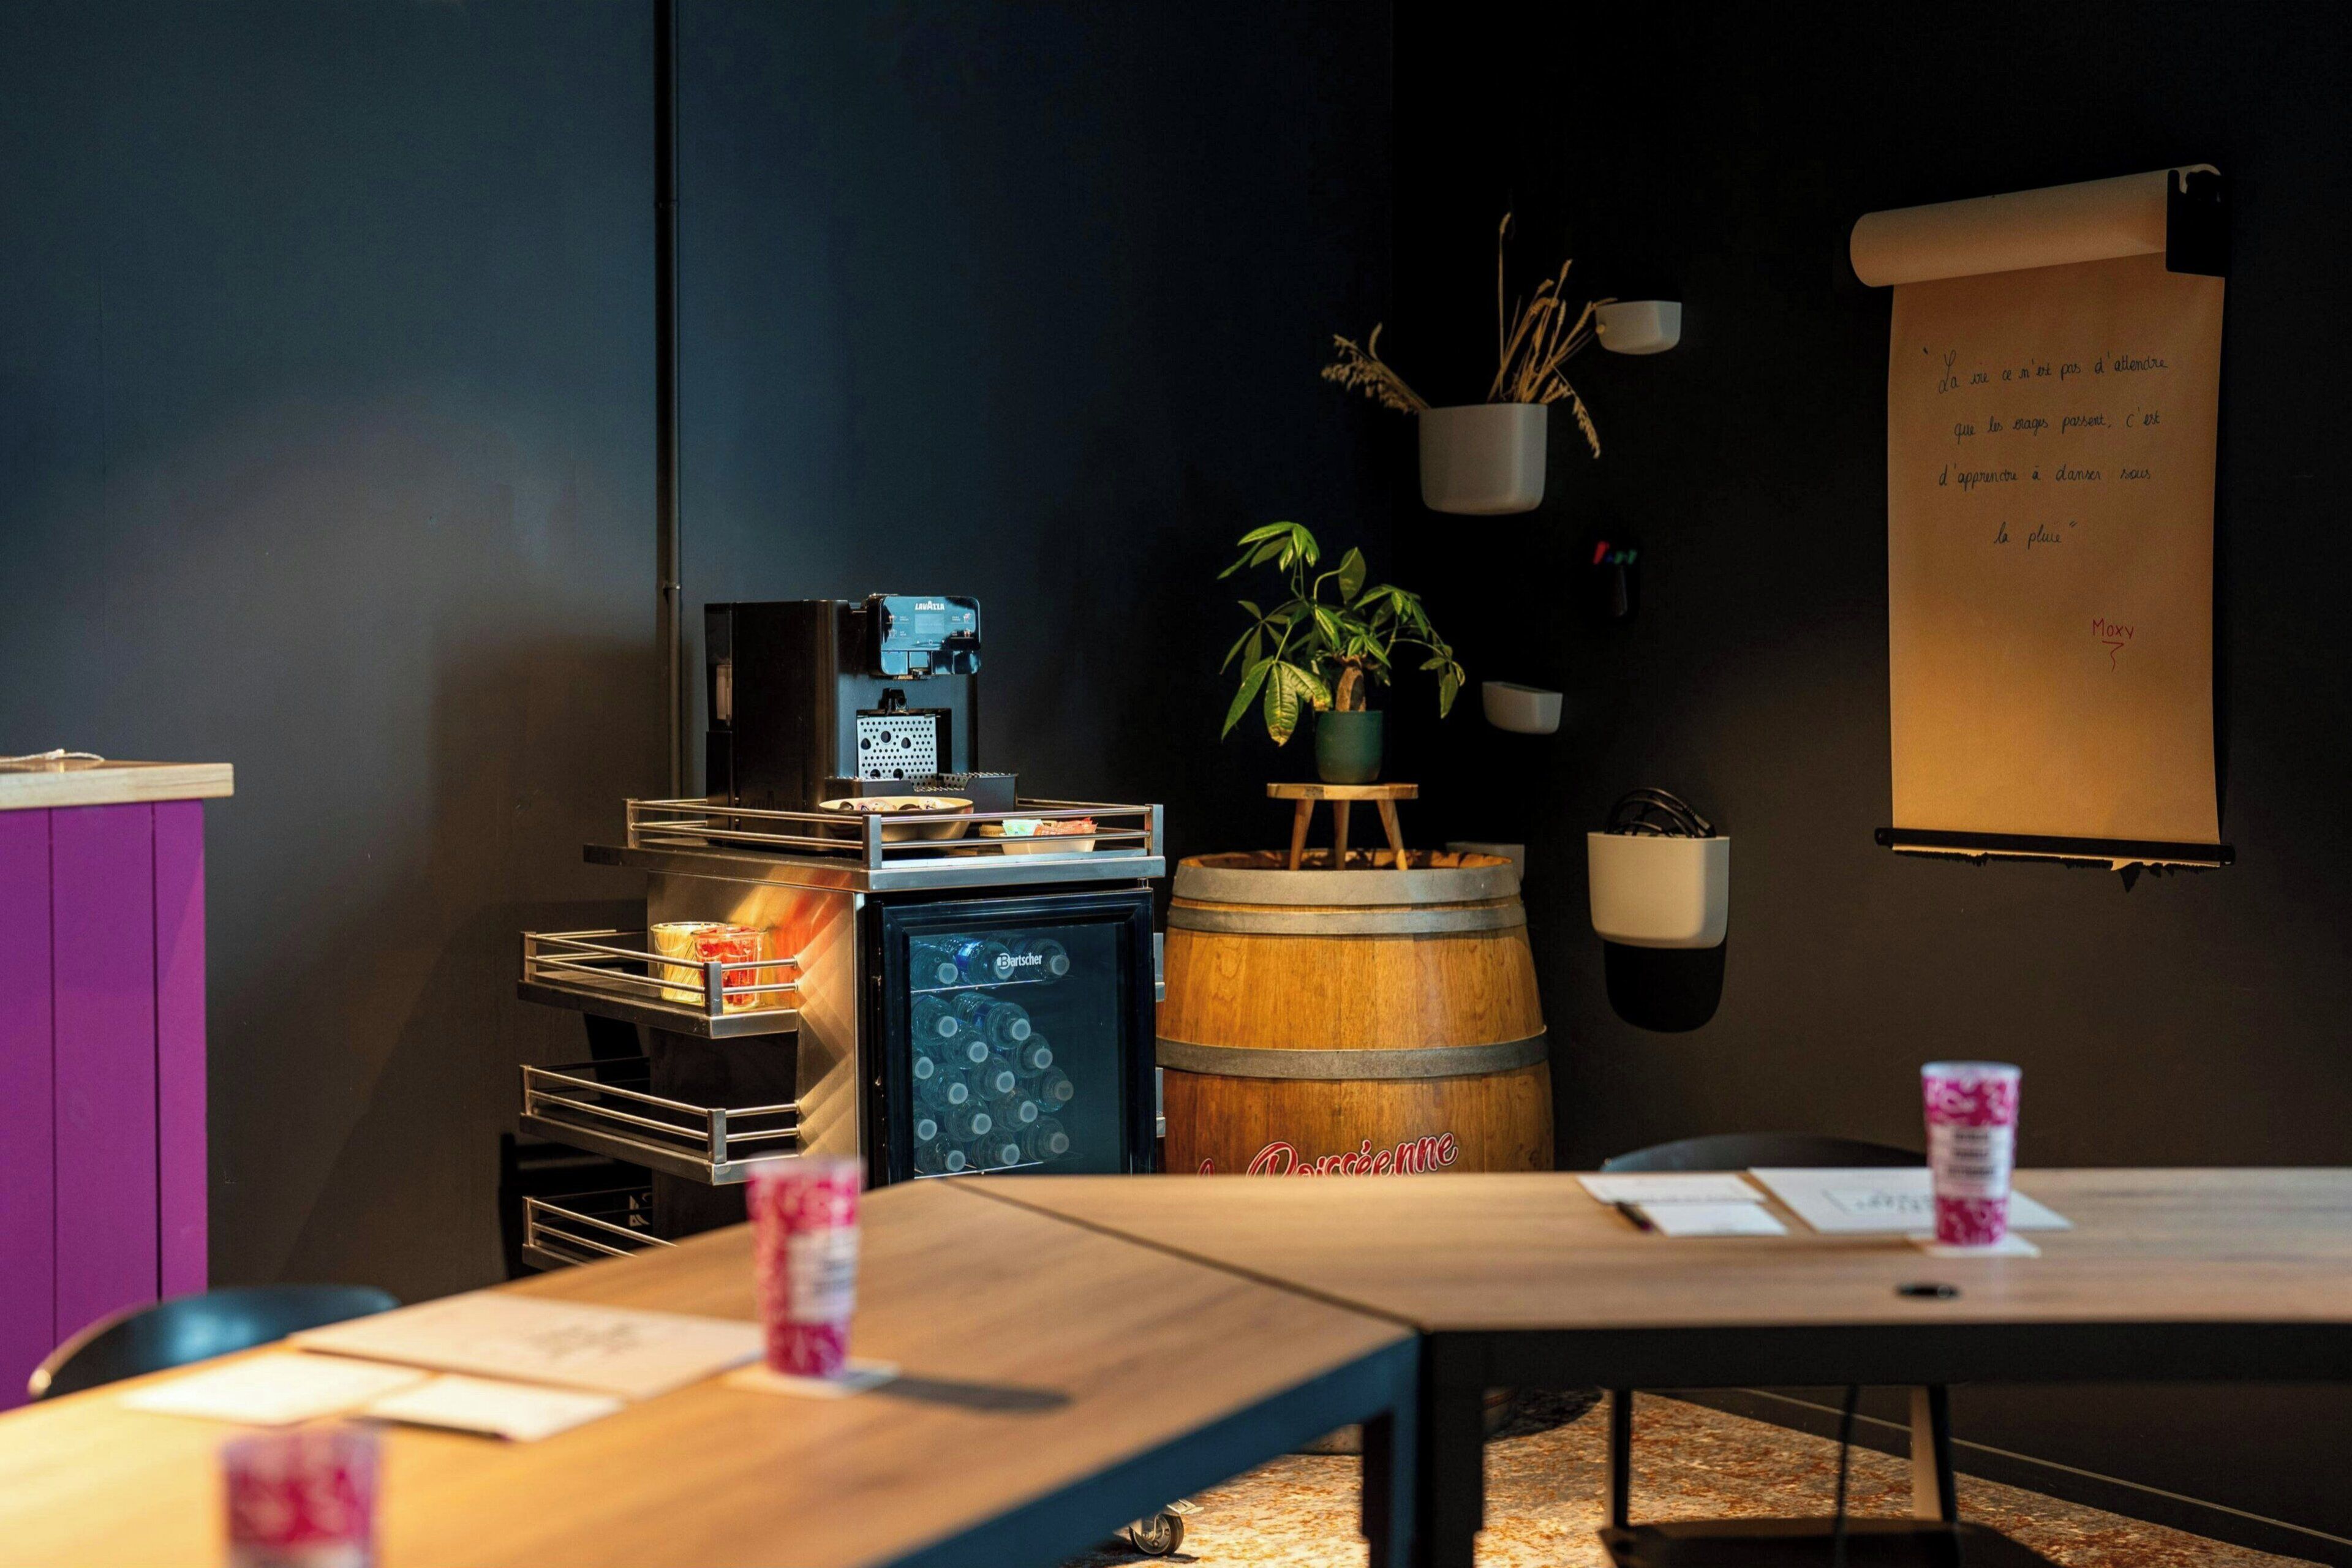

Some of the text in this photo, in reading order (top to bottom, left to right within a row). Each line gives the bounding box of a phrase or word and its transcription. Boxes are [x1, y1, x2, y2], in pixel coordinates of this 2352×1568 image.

[2060, 363, 2082, 381] pas
[1954, 423, 1976, 445] que
[1988, 415, 2003, 432] les
[2055, 464, 2101, 481] danser
[2120, 468, 2151, 480] sous
[1993, 521, 2009, 544] la
[914, 600, 945, 611] LAVAZZA
[997, 952, 1042, 970] Bartscher
